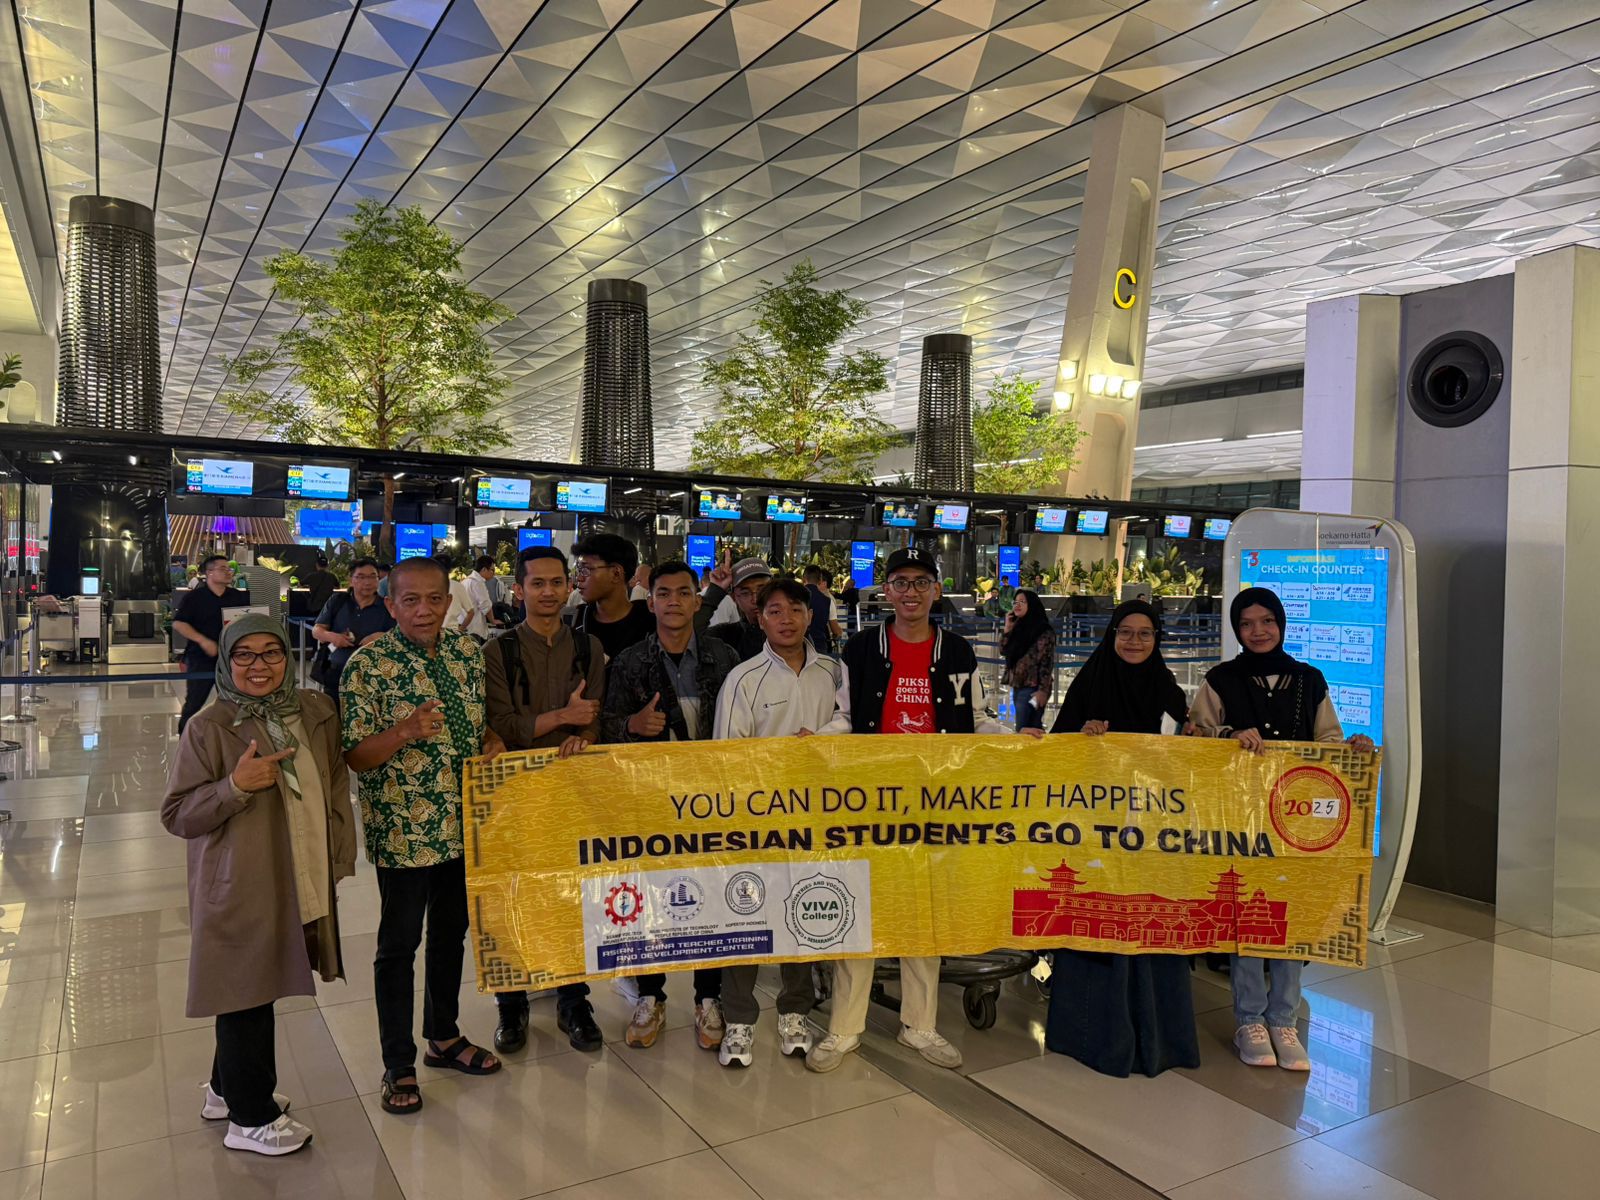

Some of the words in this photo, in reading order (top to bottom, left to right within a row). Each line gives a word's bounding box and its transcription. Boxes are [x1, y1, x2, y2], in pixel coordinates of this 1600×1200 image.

[1114, 268, 1137, 309] C
[907, 549, 919, 560] R
[1261, 565, 1309, 574] CHECK-IN
[1312, 565, 1364, 575] COUNTER
[898, 677, 929, 687] PIKSI
[896, 687, 918, 695] goes
[948, 672, 970, 706] Y
[895, 694, 930, 704] CHINA
[670, 792, 735, 820] YOU
[746, 788, 810, 816] CAN
[822, 787, 867, 813] DO
[877, 787, 909, 815] IT,
[921, 786, 1003, 811] MAKE
[1011, 784, 1037, 808] IT
[1046, 784, 1186, 814] HAPPENS
[579, 827, 812, 865] INDONESIAN
[825, 822, 1016, 849] STUDENTS
[1028, 821, 1082, 845] GO
[1094, 824, 1145, 851] TO
[1157, 828, 1275, 857] CHINA
[802, 901, 839, 911] VIVA
[802, 912, 839, 921] College
[602, 947, 634, 957] ASIAN
[645, 942, 675, 952] CHINA
[678, 939, 724, 948] TEACHER
[726, 935, 769, 943] TRAINING
[616, 953, 638, 962] AND
[641, 947, 713, 960] DEVELOPMENT
[716, 943, 754, 953] CENTER
